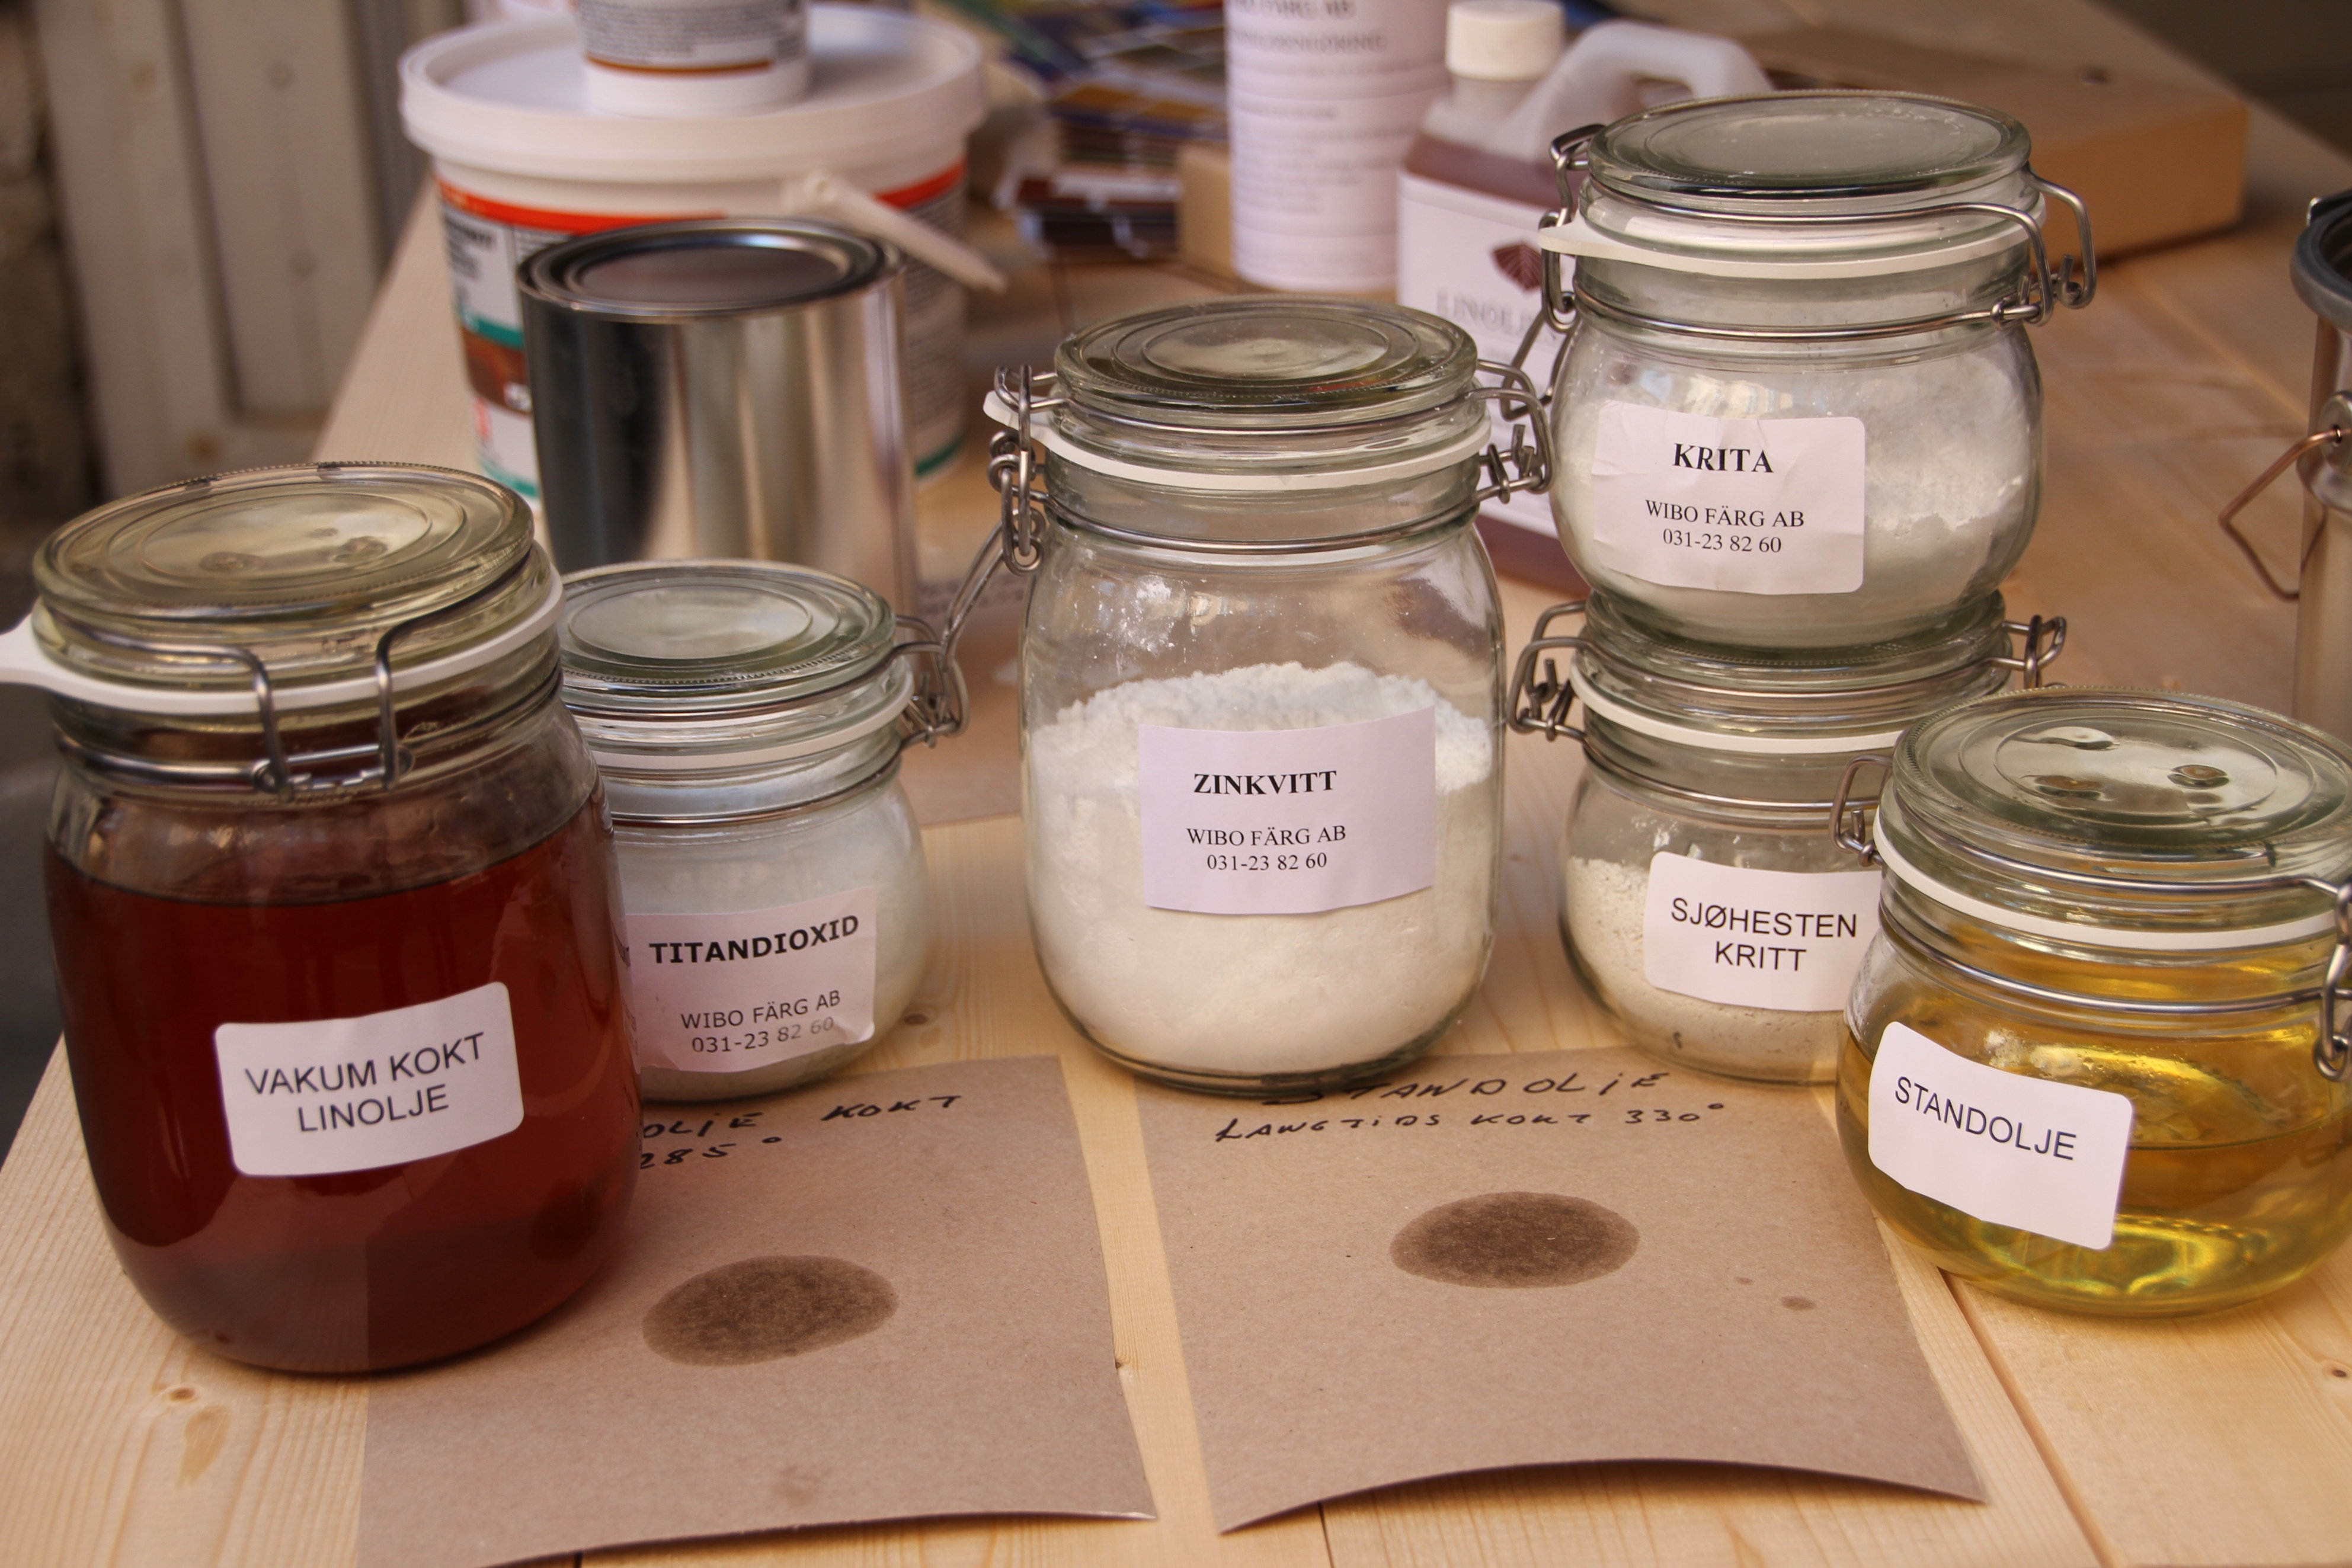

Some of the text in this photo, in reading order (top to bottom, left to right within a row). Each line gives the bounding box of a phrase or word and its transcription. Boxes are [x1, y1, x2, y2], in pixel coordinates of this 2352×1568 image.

[1673, 443, 1774, 473] KRITA
[1645, 499, 1805, 527] WIBO FÄRG AB
[1662, 528, 1782, 553] 031-23 82 60
[1193, 770, 1337, 795] ZINKVITT
[1186, 824, 1346, 847] WIBO FÄRG AB
[1207, 852, 1328, 871] 031-23 82 60
[1671, 897, 1857, 938] SJØHESTEN
[648, 914, 859, 964] TITANDIOXID
[1715, 940, 1807, 972] KRITT
[680, 989, 841, 1029] WIBO FÄRG AB
[691, 1016, 835, 1054] 031-23 82 60
[244, 1031, 485, 1095] VAKUM KOKT
[297, 1083, 450, 1132] LINOLJE
[821, 1094, 963, 1122] KOKT
[1895, 1075, 2078, 1161] STANDOLJE
